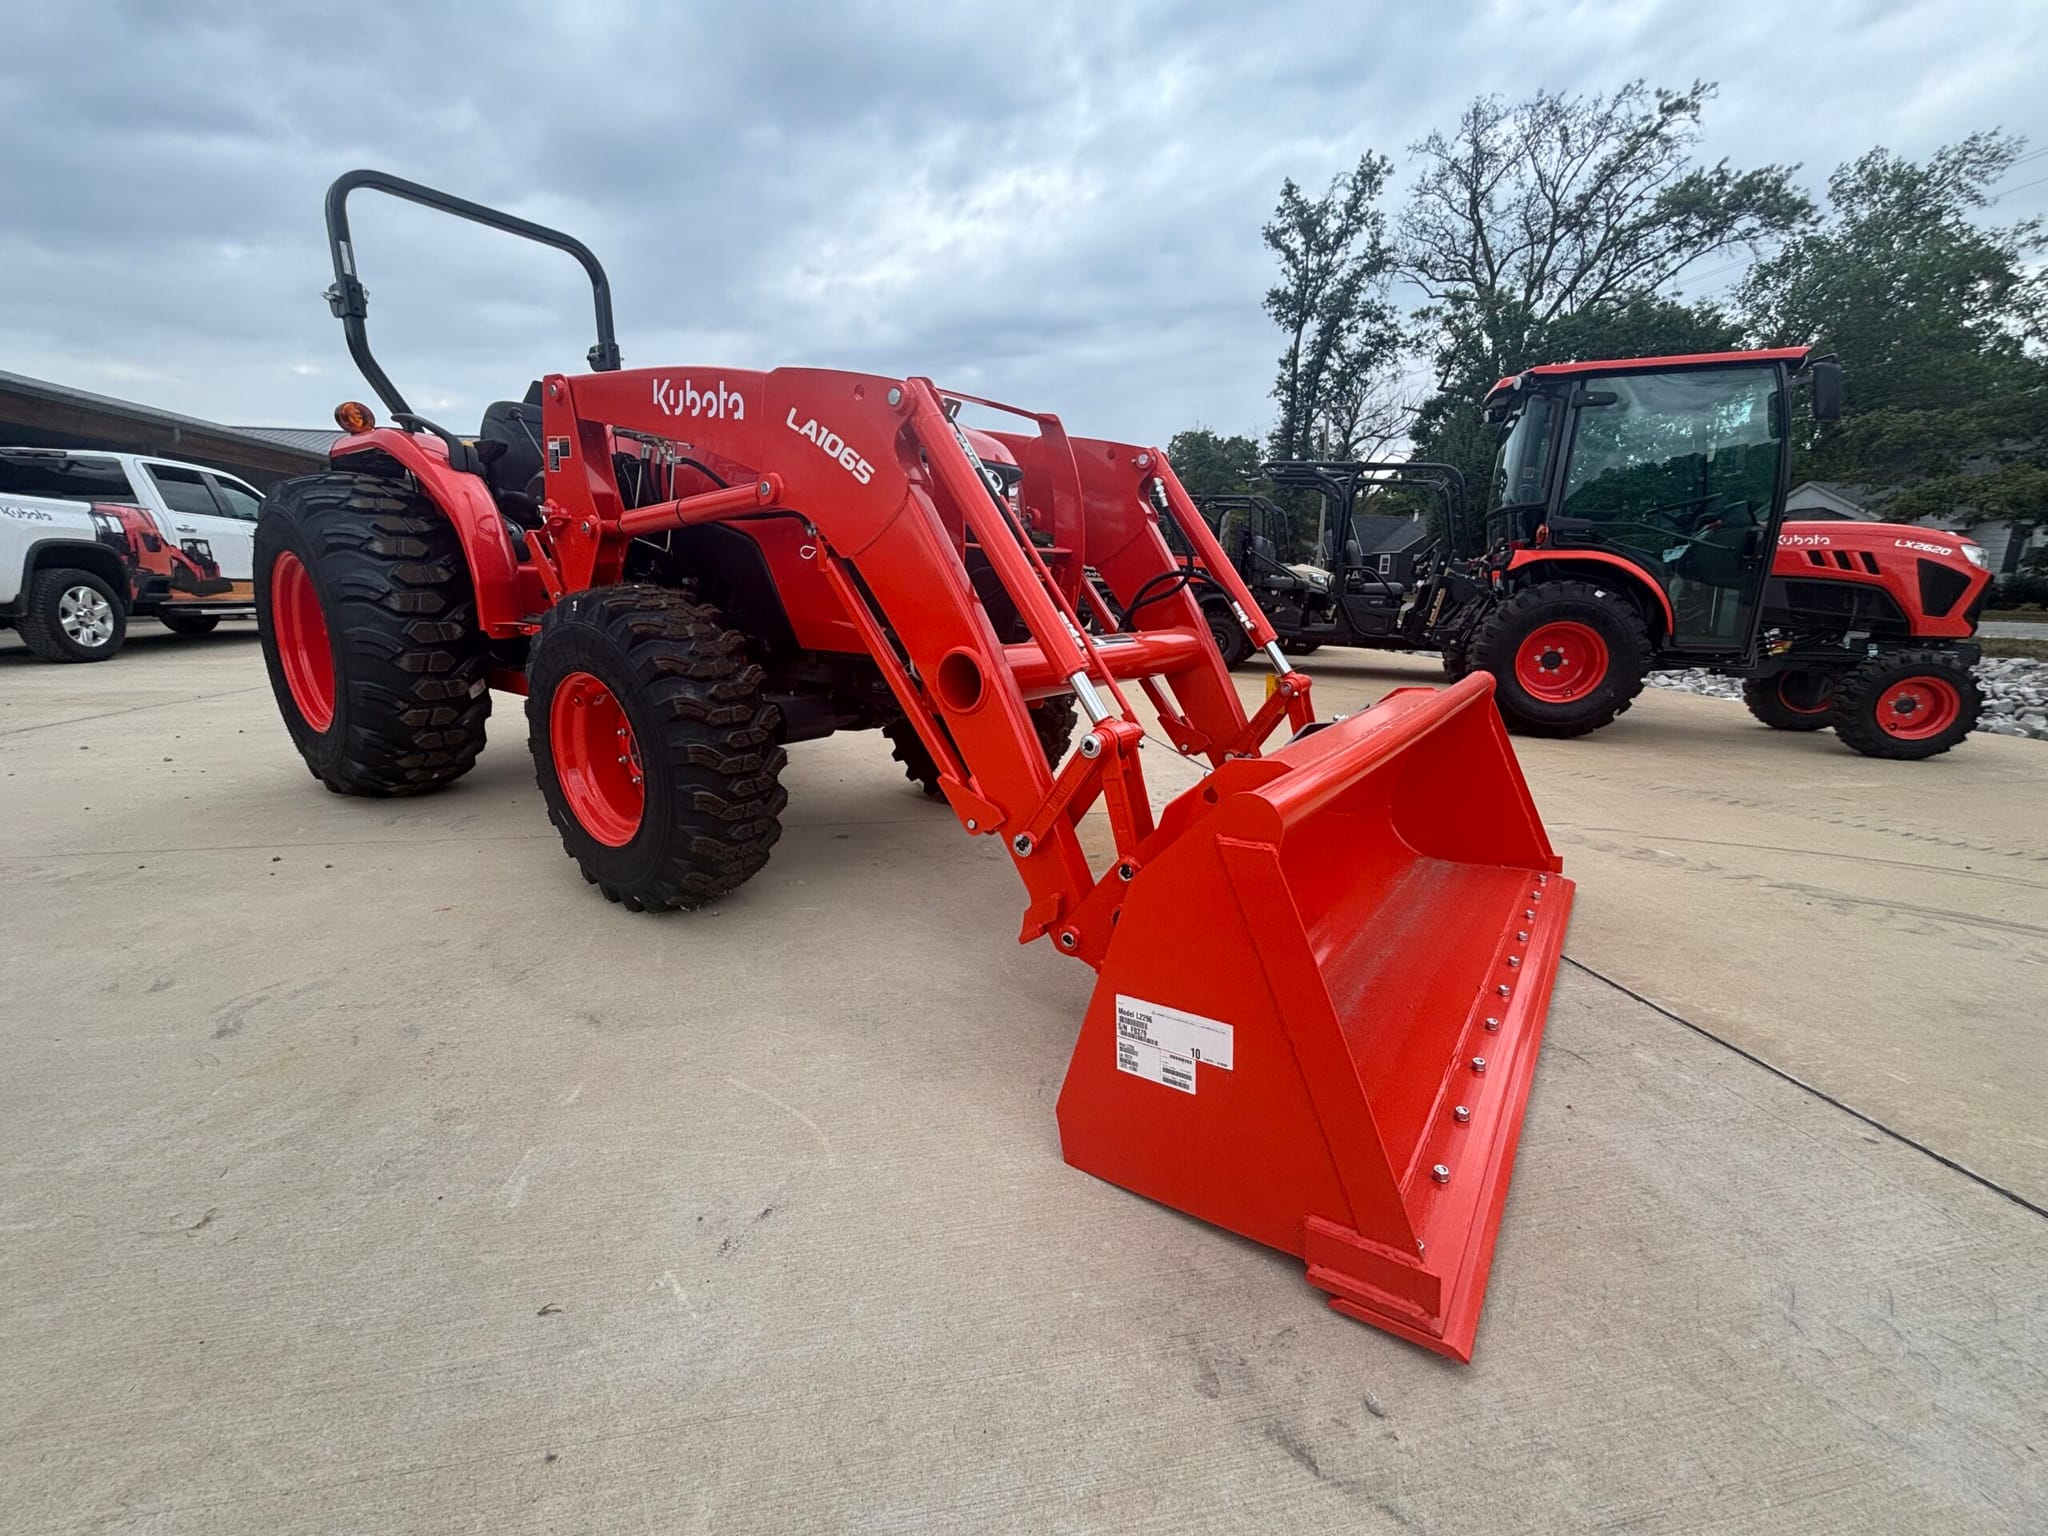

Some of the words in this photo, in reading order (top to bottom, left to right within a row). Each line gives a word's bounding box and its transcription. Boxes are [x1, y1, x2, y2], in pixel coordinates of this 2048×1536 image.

[653, 378, 745, 421] Kubota
[785, 407, 876, 486] LA1065
[0, 506, 53, 521] Kubota
[1894, 539, 1953, 556] LX2620
[1118, 1007, 1135, 1018] Model
[1191, 1047, 1201, 1060] 10
